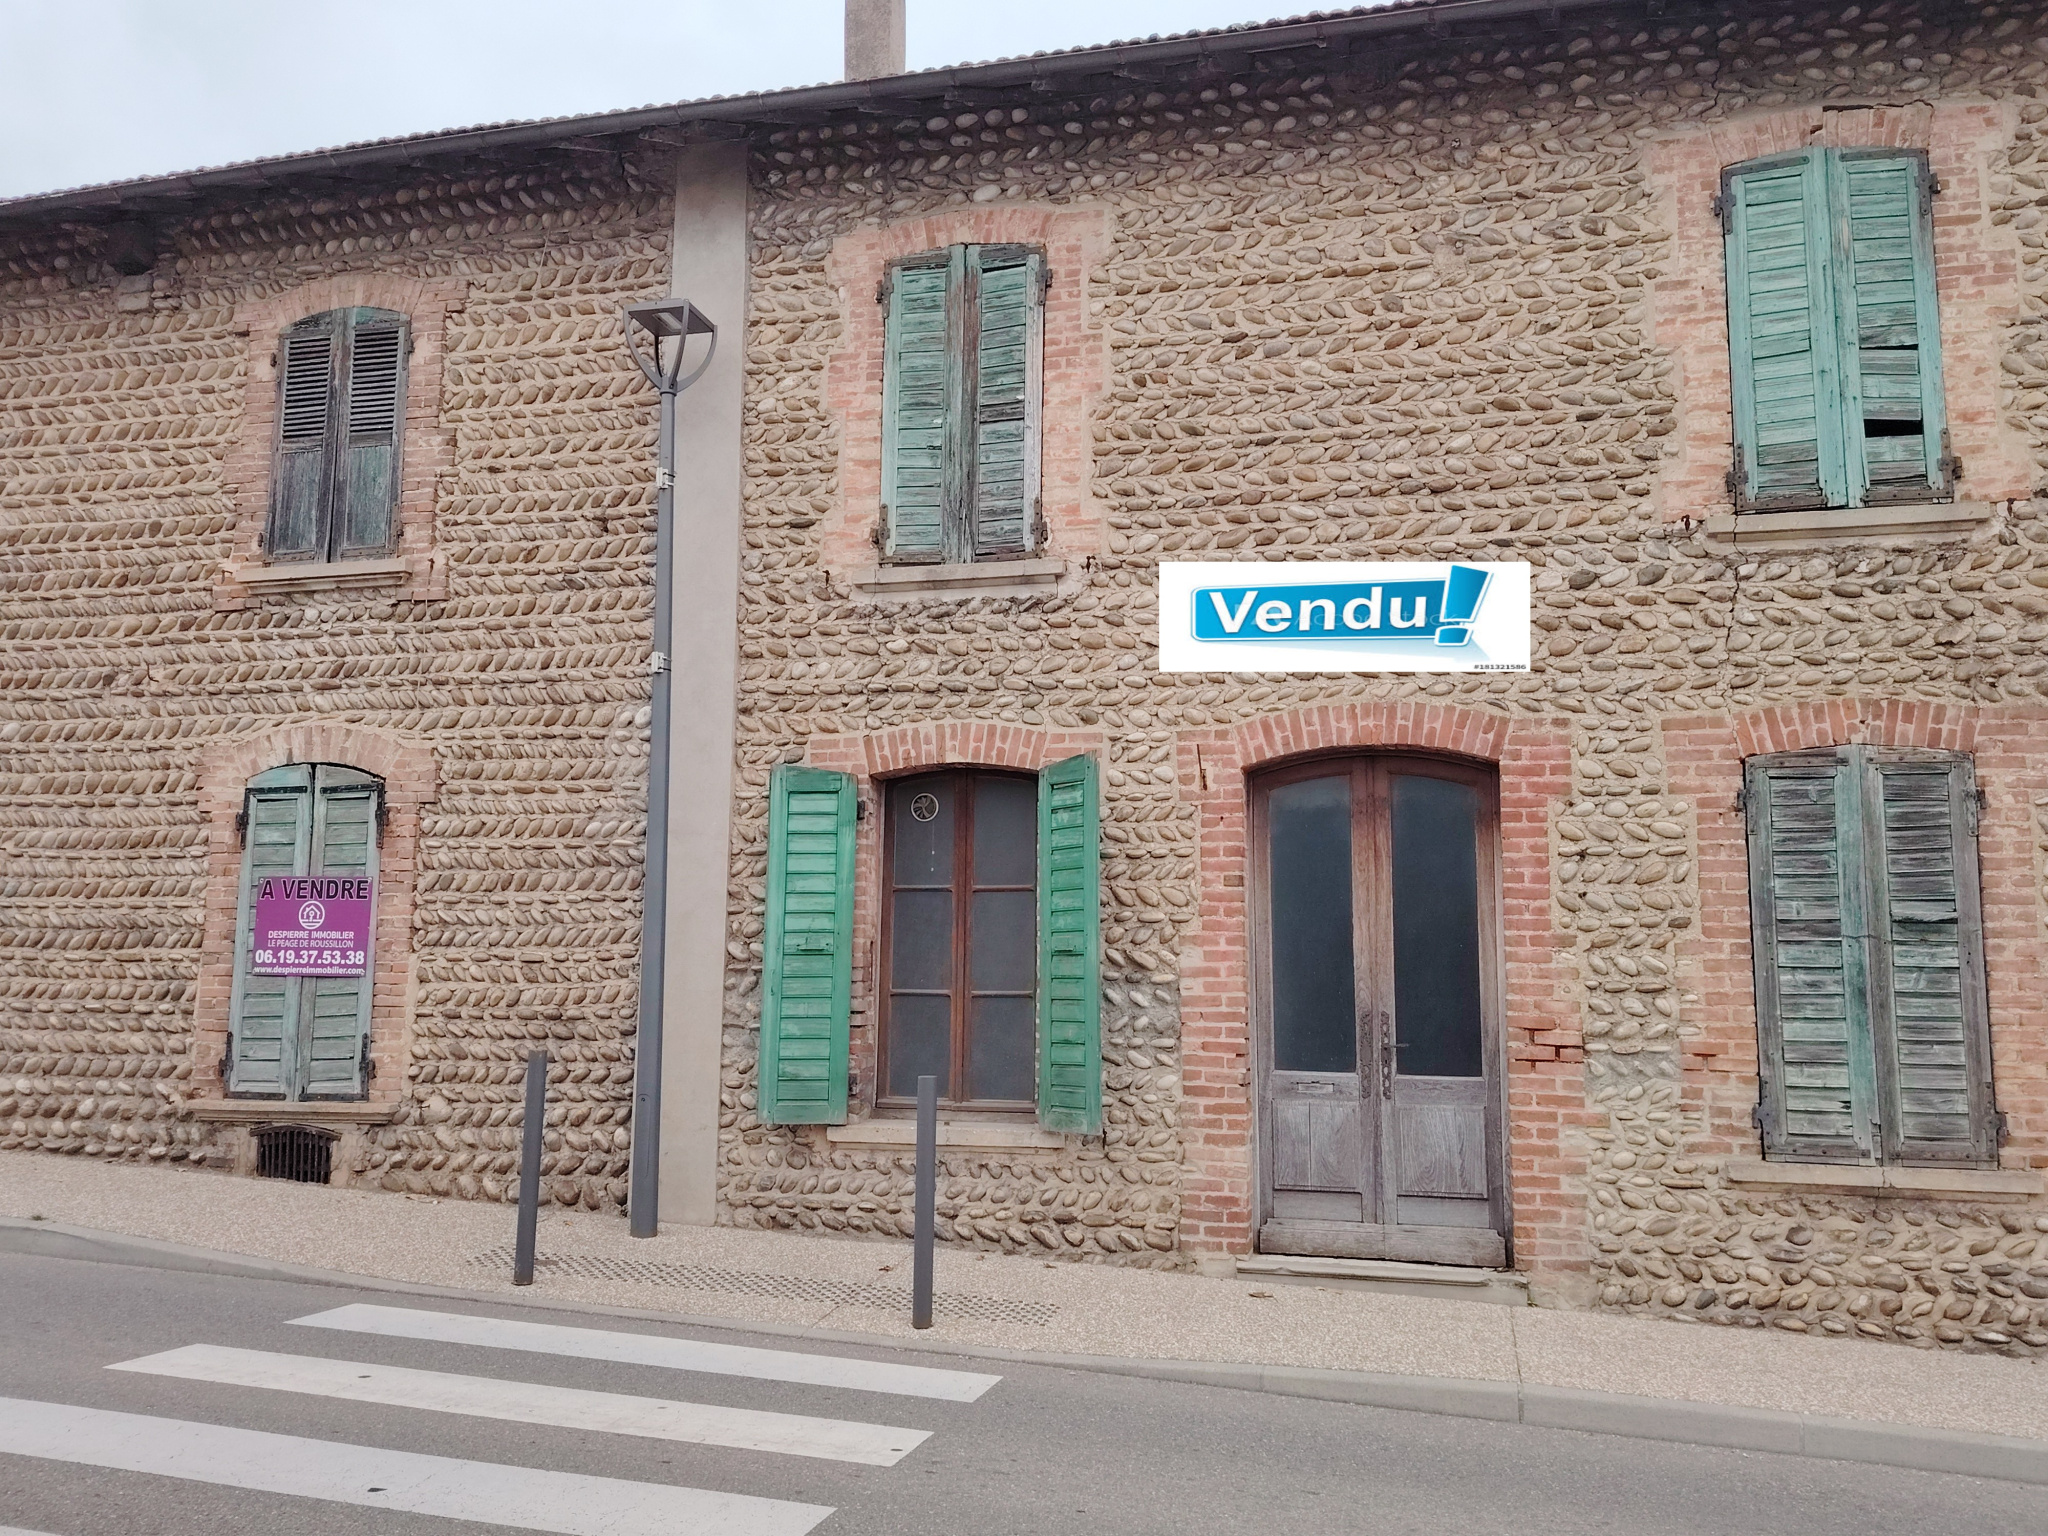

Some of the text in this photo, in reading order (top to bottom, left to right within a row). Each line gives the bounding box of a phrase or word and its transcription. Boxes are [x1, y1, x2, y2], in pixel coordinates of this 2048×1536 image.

[260, 878, 370, 900] A VENDRE
[268, 930, 355, 940] DESPIERRE IMMOBILIER
[267, 939, 354, 948] LE PEAGE DE ROUSSILLON
[255, 949, 365, 965] 06.19.37.53.38
[254, 965, 365, 975] www.despierreimmobilier.com
